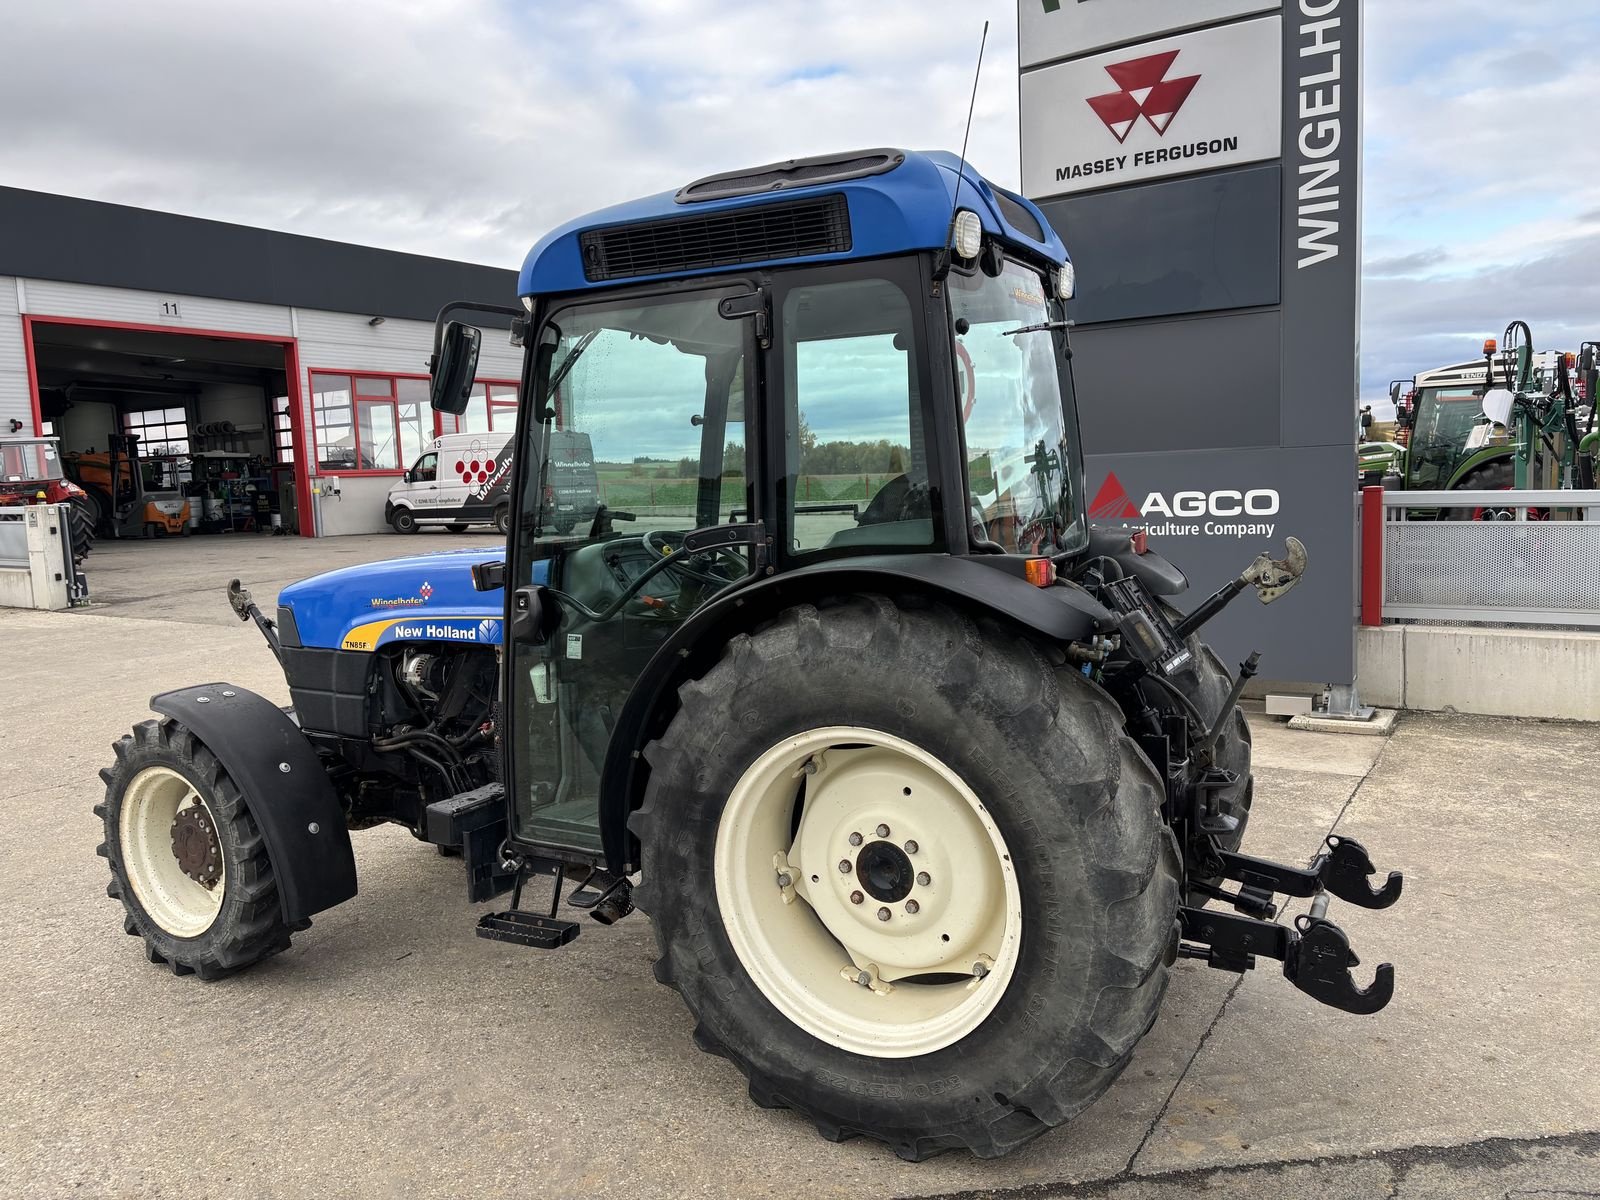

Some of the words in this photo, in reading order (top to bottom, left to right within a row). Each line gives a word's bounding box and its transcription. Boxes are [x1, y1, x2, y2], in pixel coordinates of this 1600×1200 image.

[1055, 156, 1127, 181] MASSEY
[1134, 136, 1238, 167] FERGUSON
[162, 302, 178, 315] 11
[433, 439, 441, 449] 13
[476, 452, 514, 501] Wingelh
[1139, 488, 1280, 517] AGCO
[1204, 521, 1275, 538] Company
[395, 626, 423, 638] New
[426, 624, 476, 640] Holland
[345, 641, 367, 649] TN85F
